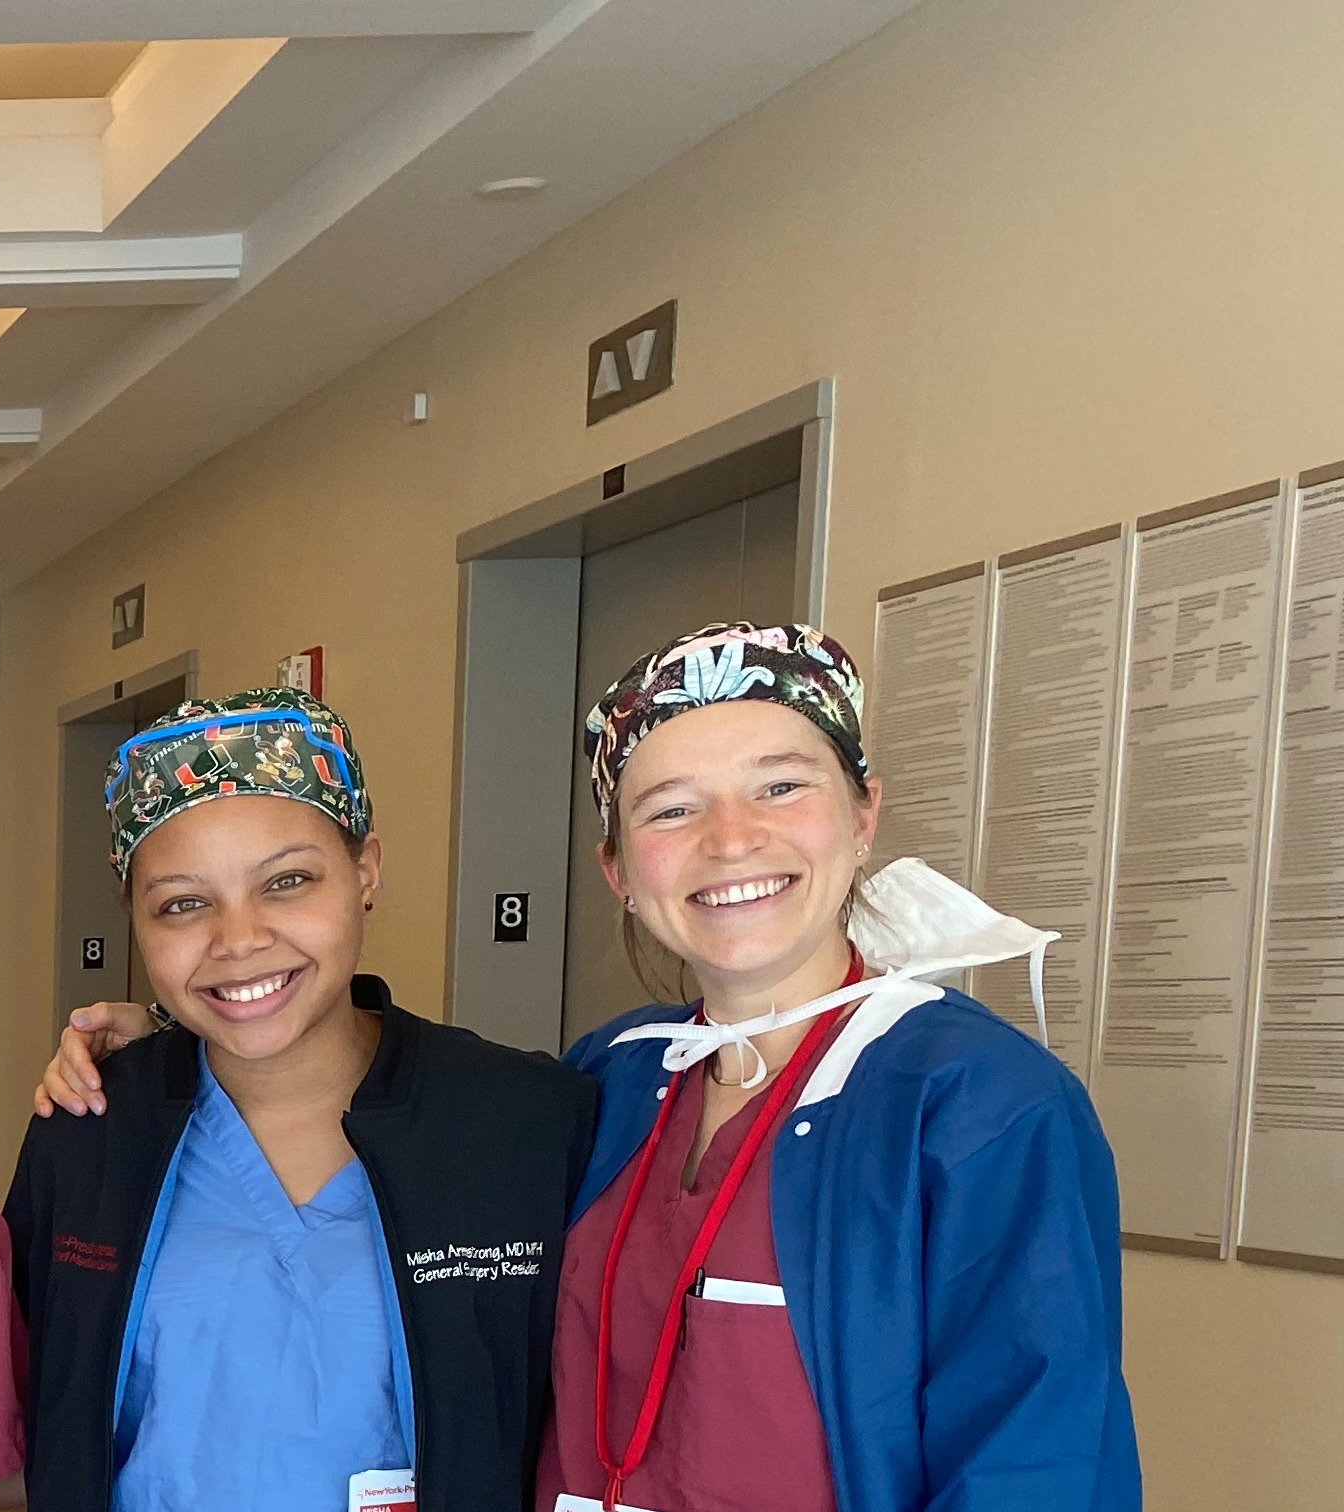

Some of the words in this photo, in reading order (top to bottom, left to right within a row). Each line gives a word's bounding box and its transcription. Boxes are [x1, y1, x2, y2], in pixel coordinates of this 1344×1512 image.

[295, 662, 304, 688] FIR
[500, 896, 522, 928] 8
[86, 939, 101, 961] 8
[406, 1248, 445, 1267] Misha
[506, 1241, 524, 1257] MD
[413, 1261, 463, 1284] General
